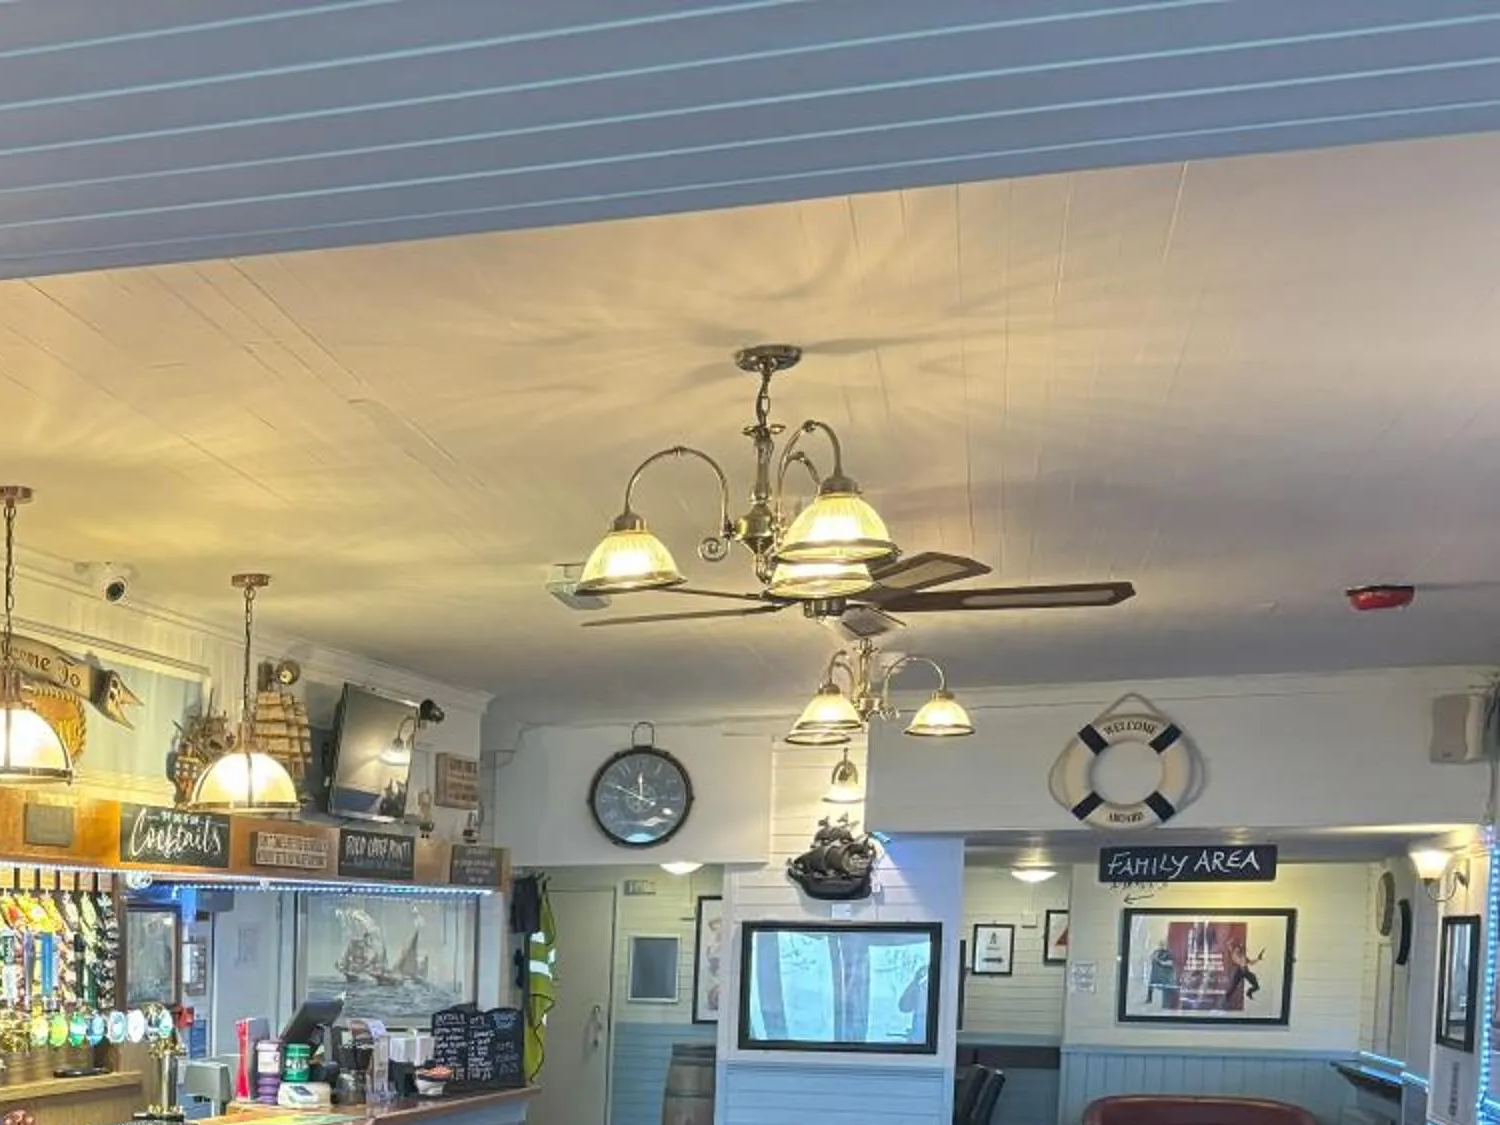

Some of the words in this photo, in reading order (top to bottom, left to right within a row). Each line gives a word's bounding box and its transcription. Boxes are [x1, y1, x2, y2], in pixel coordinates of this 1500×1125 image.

[57, 655, 81, 689] To
[1103, 719, 1156, 735] WELCOME
[131, 807, 221, 858] Cocktails
[1107, 851, 1189, 879] FAMILY
[1193, 849, 1260, 873] AREA
